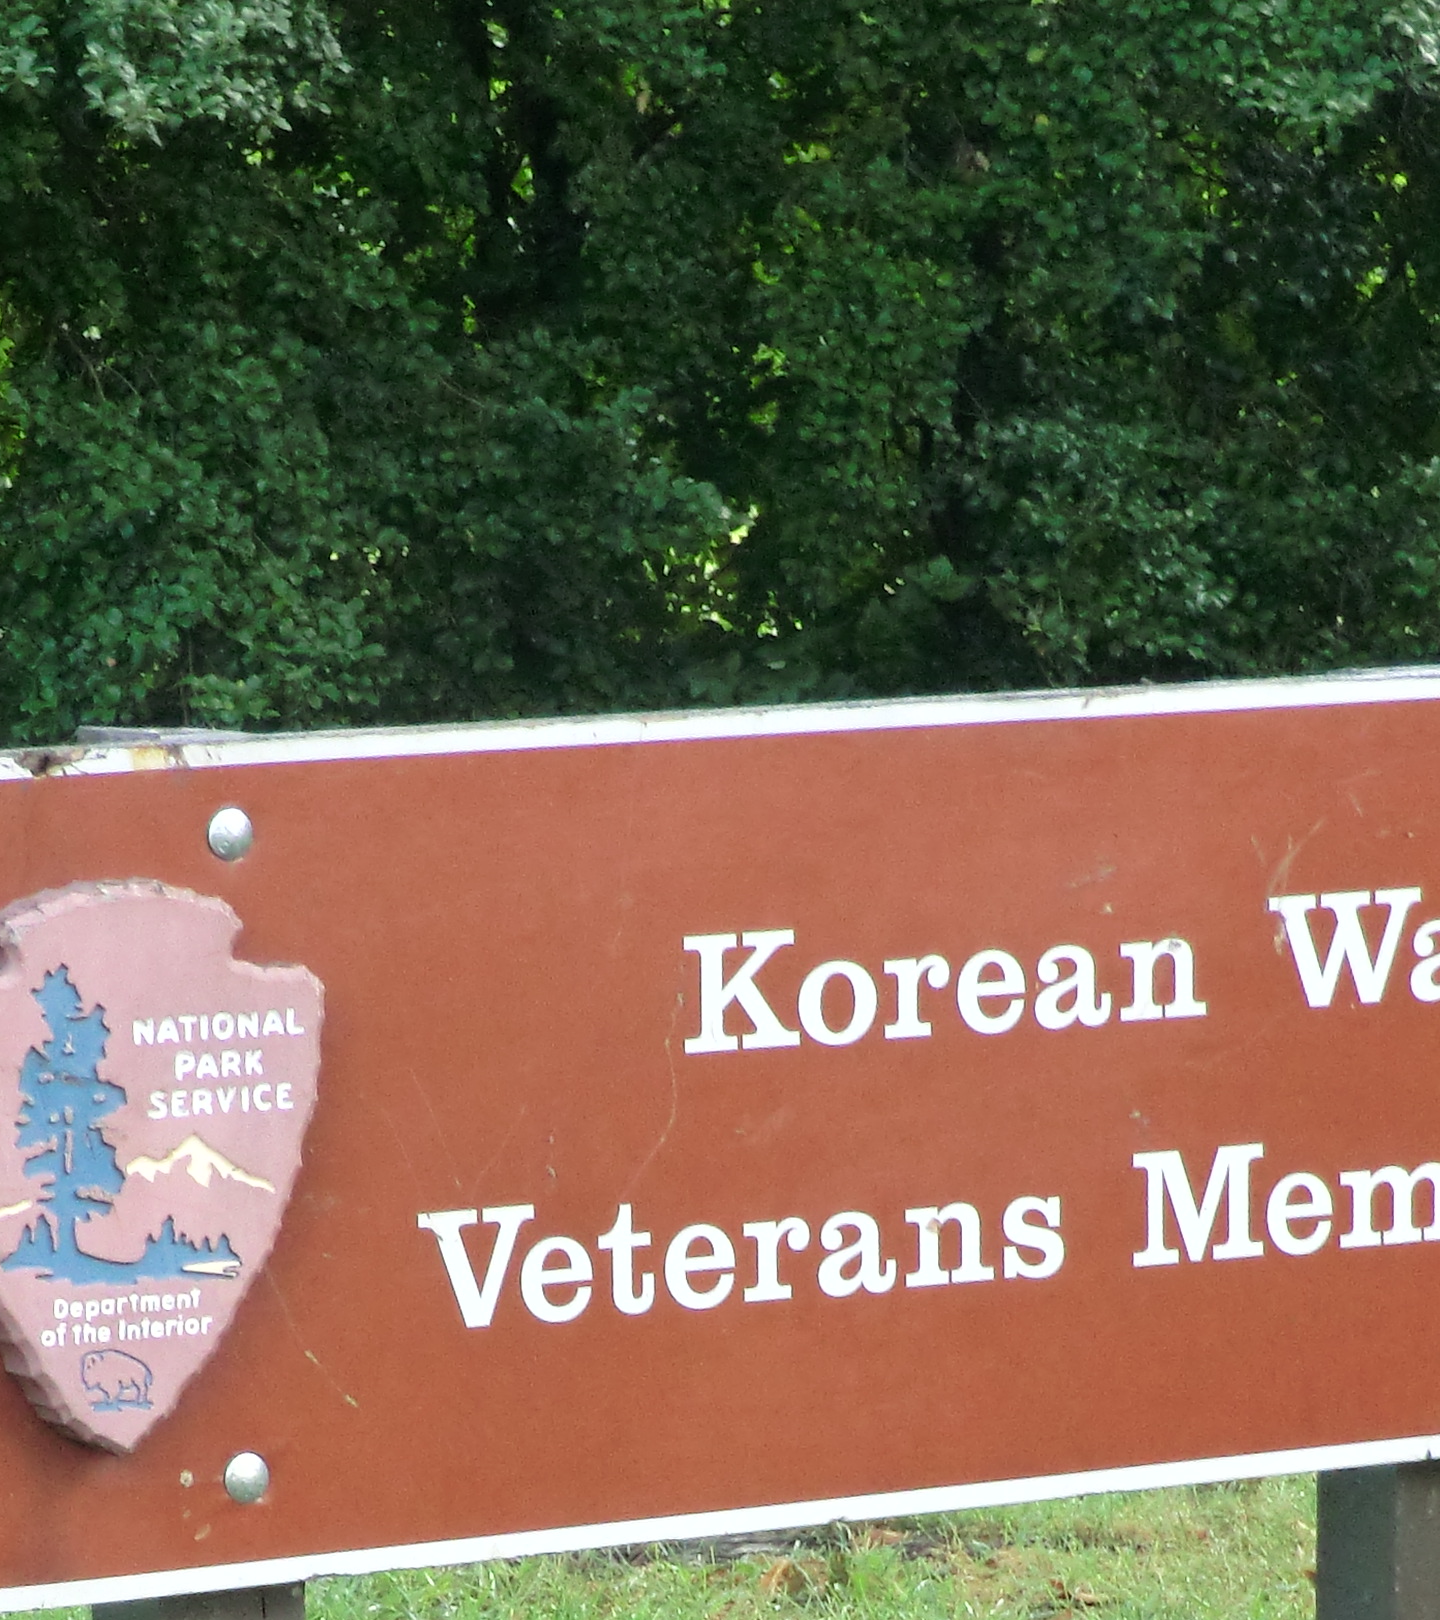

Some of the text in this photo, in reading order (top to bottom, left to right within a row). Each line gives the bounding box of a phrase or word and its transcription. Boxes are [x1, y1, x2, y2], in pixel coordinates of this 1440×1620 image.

[682, 929, 1207, 1056] Korean
[132, 1008, 306, 1046] NATIONAL
[173, 1049, 264, 1081] PARK
[146, 1082, 295, 1121] SERVICE
[418, 1192, 1065, 1329] Veterans
[53, 1287, 201, 1321] Department
[40, 1313, 213, 1348] of the Interior
